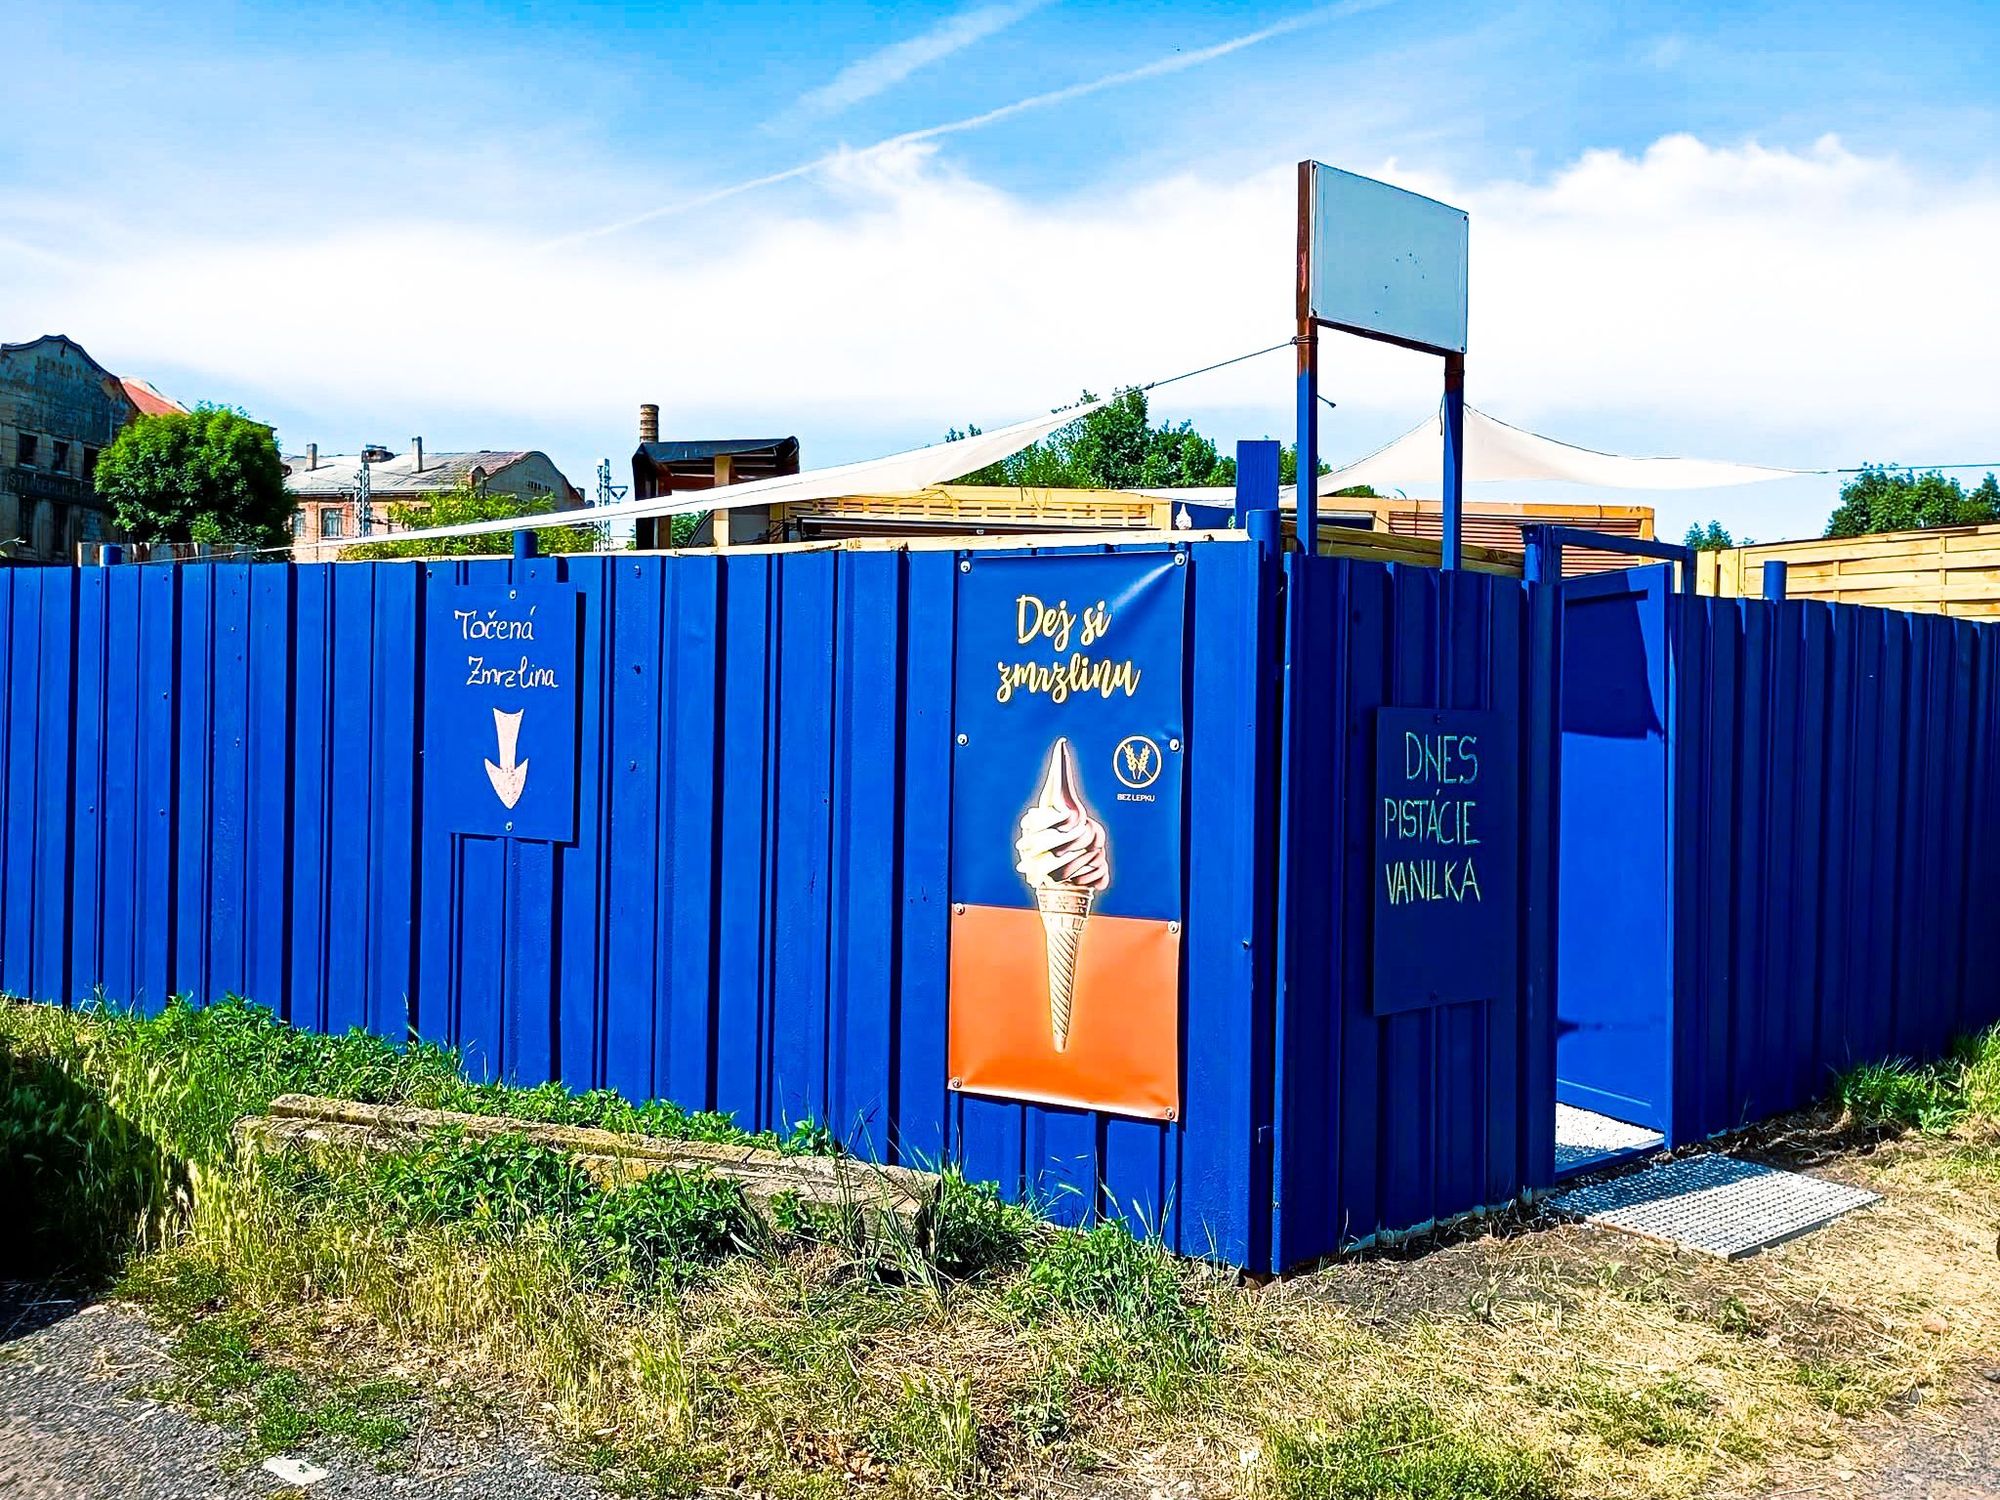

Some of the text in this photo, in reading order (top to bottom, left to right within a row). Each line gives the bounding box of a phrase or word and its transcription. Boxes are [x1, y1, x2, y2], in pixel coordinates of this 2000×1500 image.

[454, 605, 536, 640] Točená
[1016, 594, 1111, 652] Dej si
[466, 655, 559, 689] Zmrzlina
[997, 653, 1141, 704] zmrzlinu
[1405, 731, 1478, 784] DNES
[1117, 793, 1156, 802] BEZ LEPKU
[1384, 788, 1481, 845] PISTÁCIE
[1385, 857, 1481, 905] VANILKA
